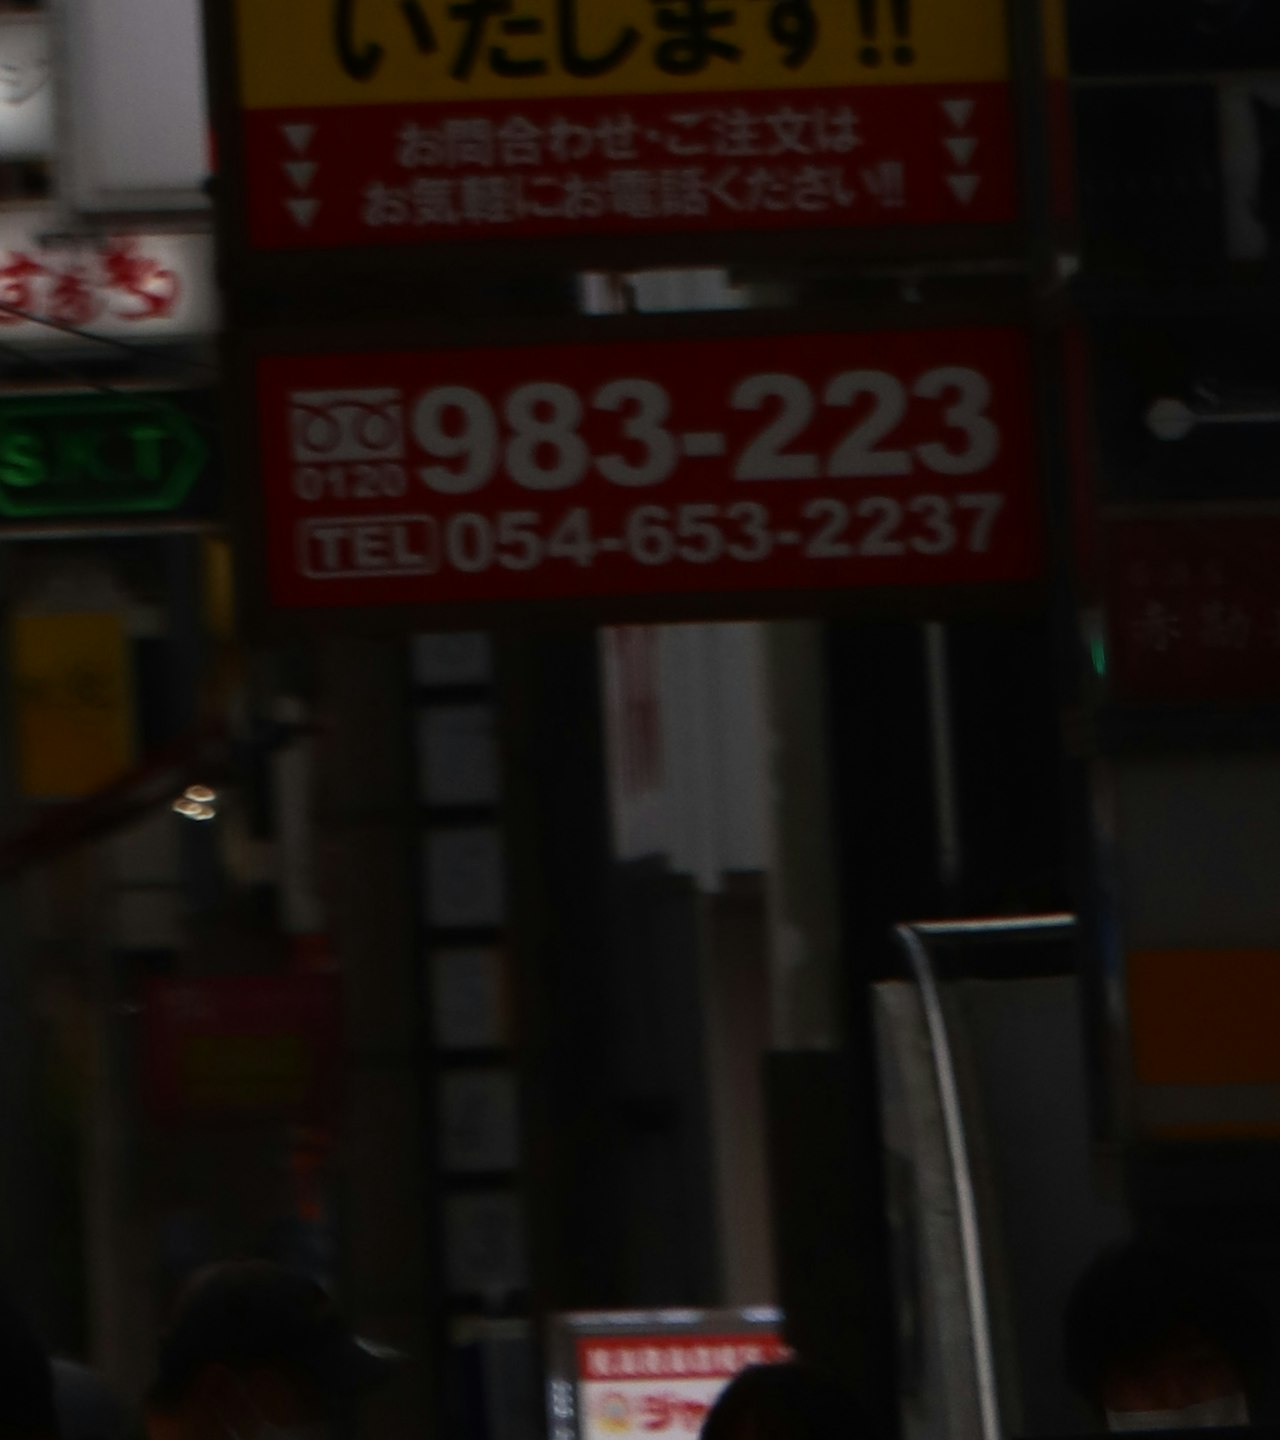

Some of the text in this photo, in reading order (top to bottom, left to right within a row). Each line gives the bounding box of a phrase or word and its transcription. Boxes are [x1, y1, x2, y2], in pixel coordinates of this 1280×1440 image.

[410, 366, 1002, 496] 983-223
[310, 492, 1006, 574] TEL 054-653-2237
